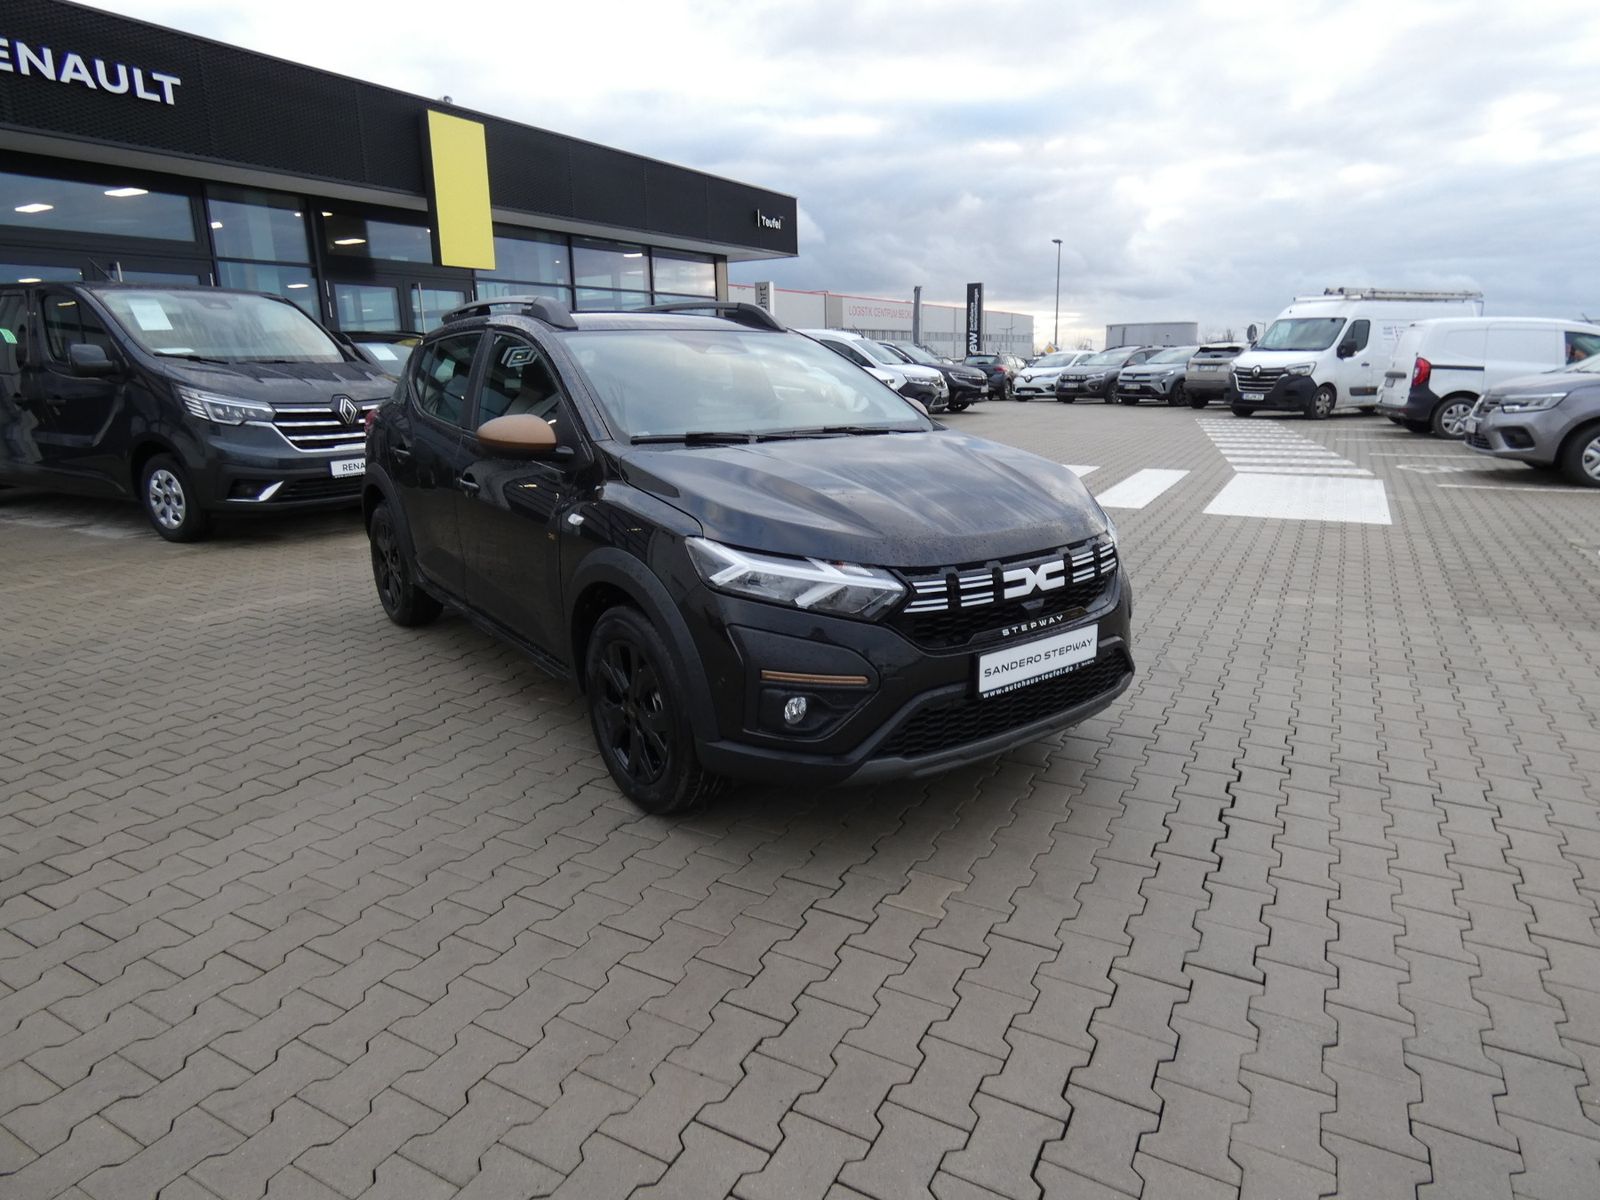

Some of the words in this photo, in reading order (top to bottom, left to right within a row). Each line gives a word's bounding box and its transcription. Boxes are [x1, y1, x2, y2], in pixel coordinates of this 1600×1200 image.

[0, 37, 181, 105] ENAULT
[761, 215, 781, 230] Teufel
[848, 305, 873, 317] LOGISTIK
[342, 462, 366, 471] RENA
[1002, 614, 1063, 636] STEPWAY
[984, 654, 1042, 677] SANDERO
[1044, 639, 1093, 660] STEPWAY
[983, 665, 1074, 698] www.autohaus-teufel.de
